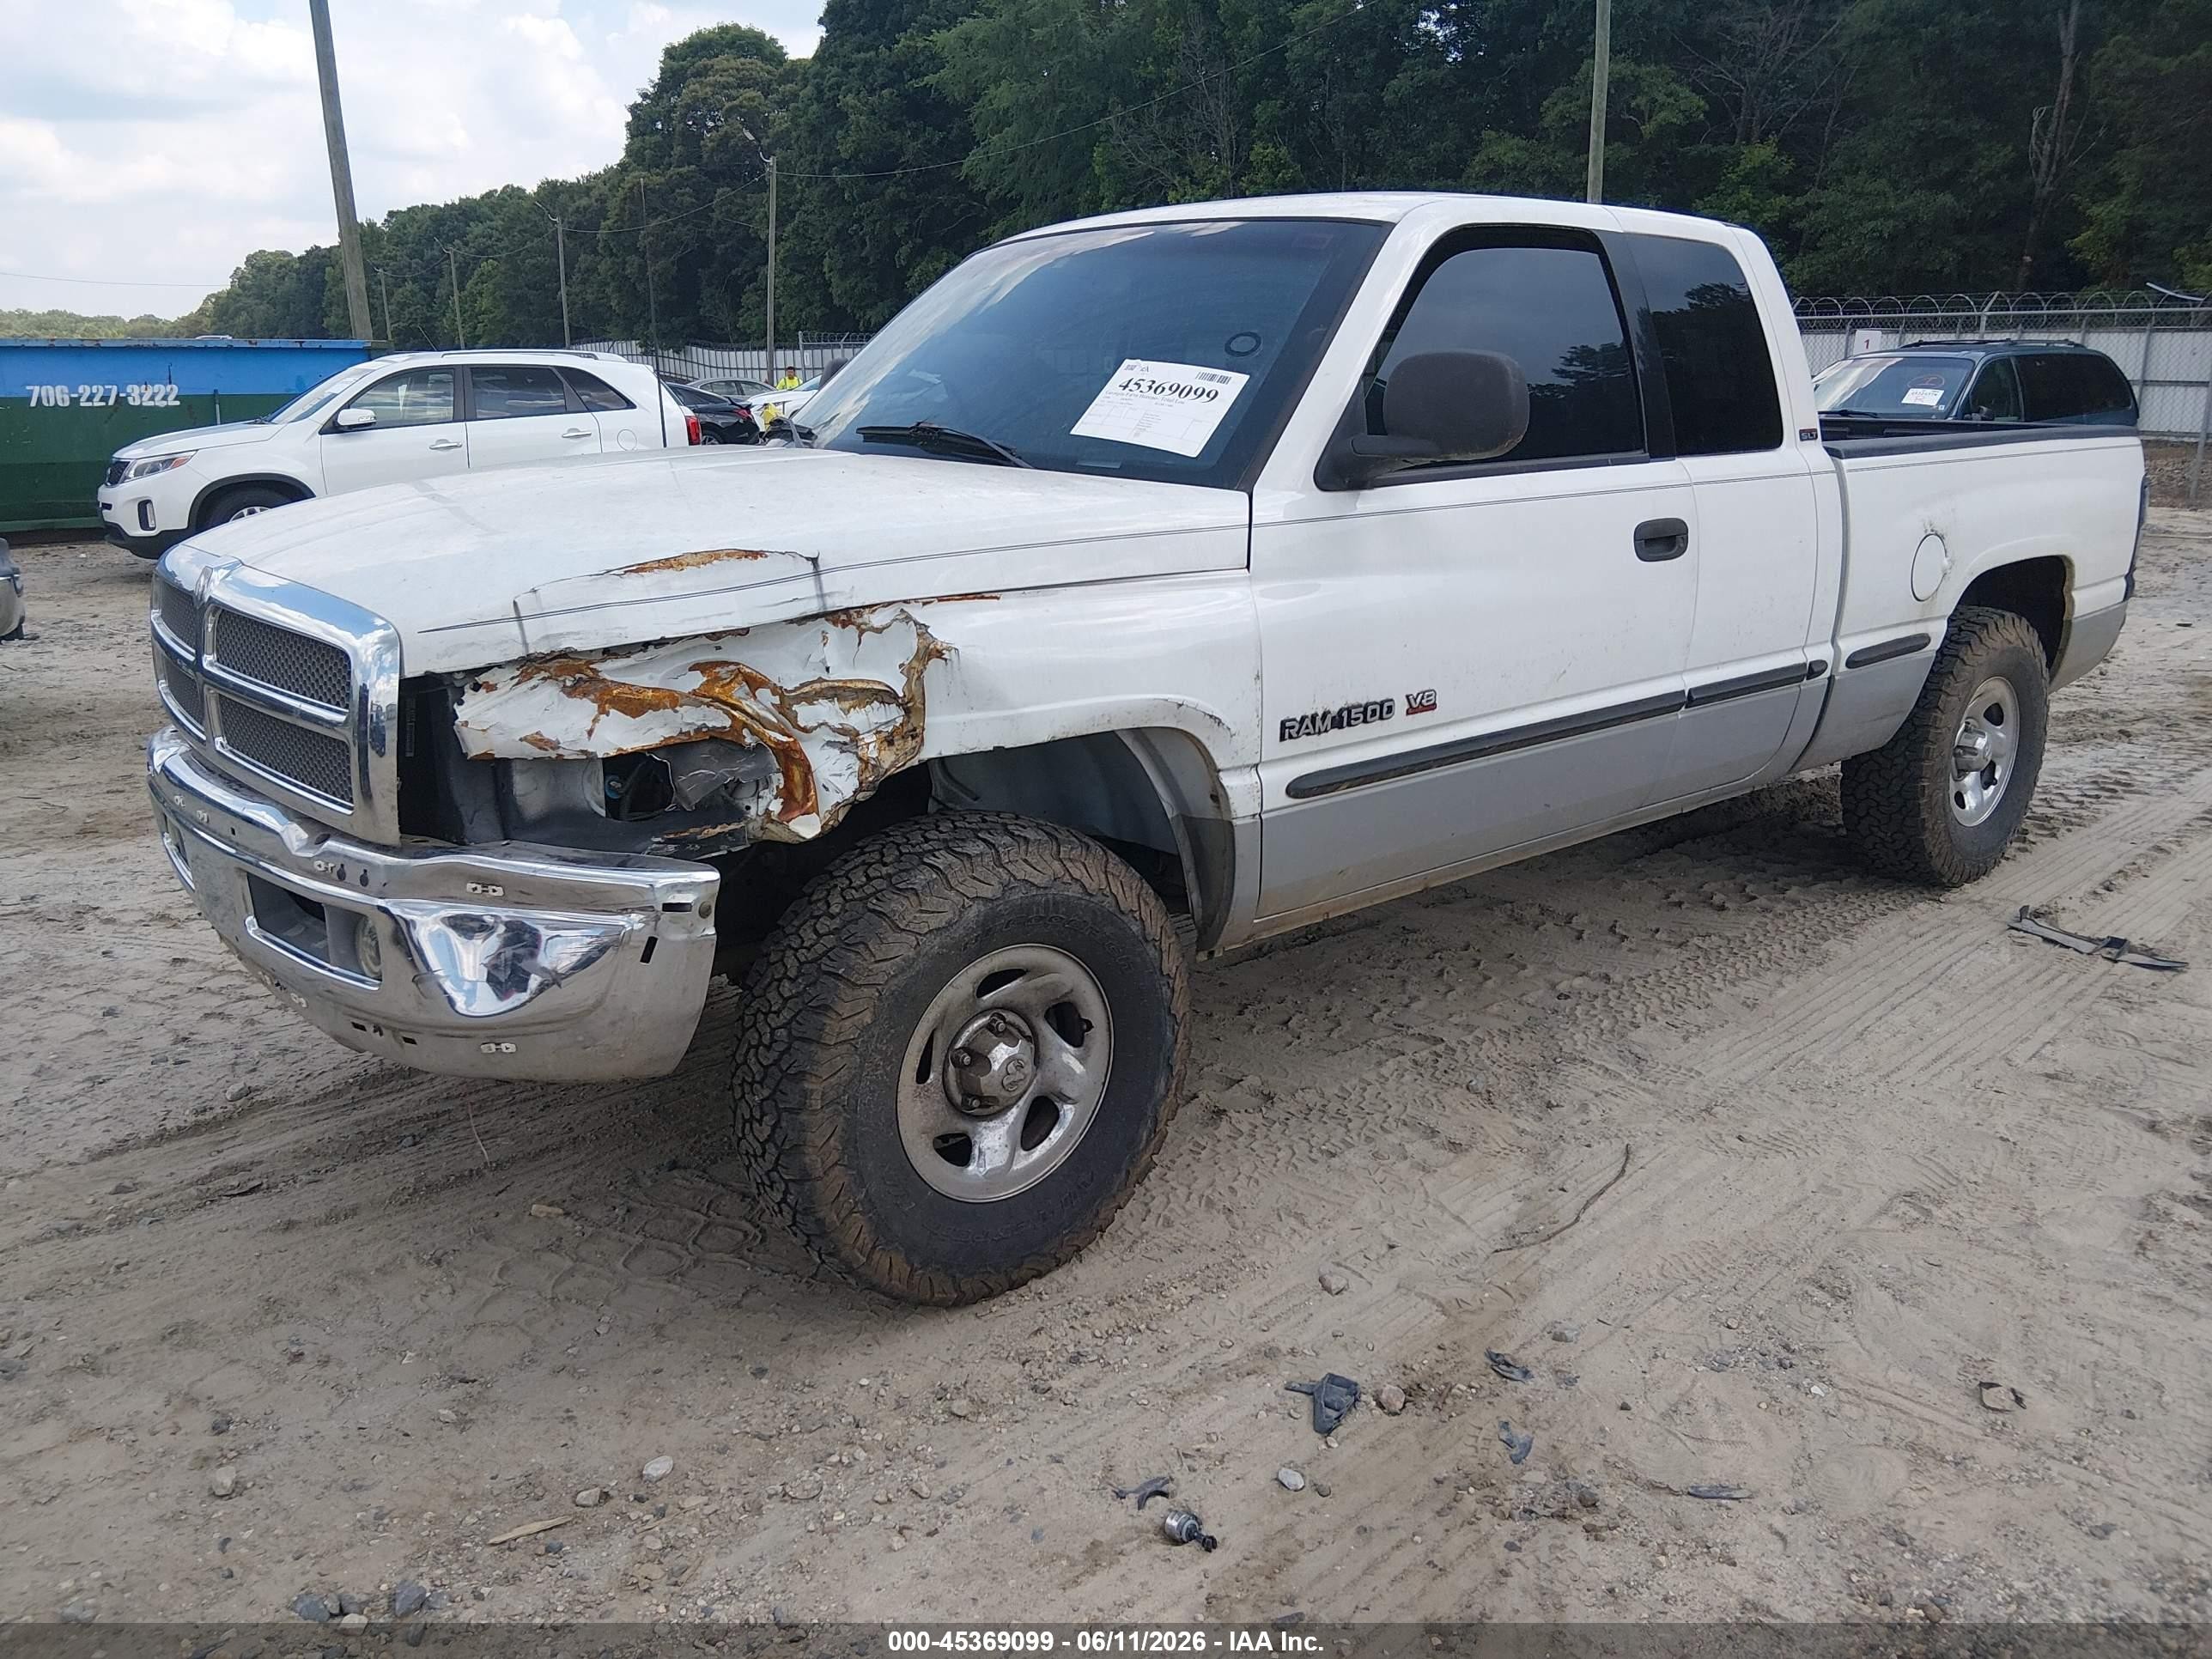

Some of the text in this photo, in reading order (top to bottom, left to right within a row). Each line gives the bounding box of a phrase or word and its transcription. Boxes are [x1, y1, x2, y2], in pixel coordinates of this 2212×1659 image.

[1864, 338, 1870, 349] 1
[26, 384, 181, 408] 706-227-3222
[1118, 377, 1219, 404] 45369099
[1801, 431, 1817, 440] SLT
[1280, 690, 1437, 742] RAM 1500 V8
